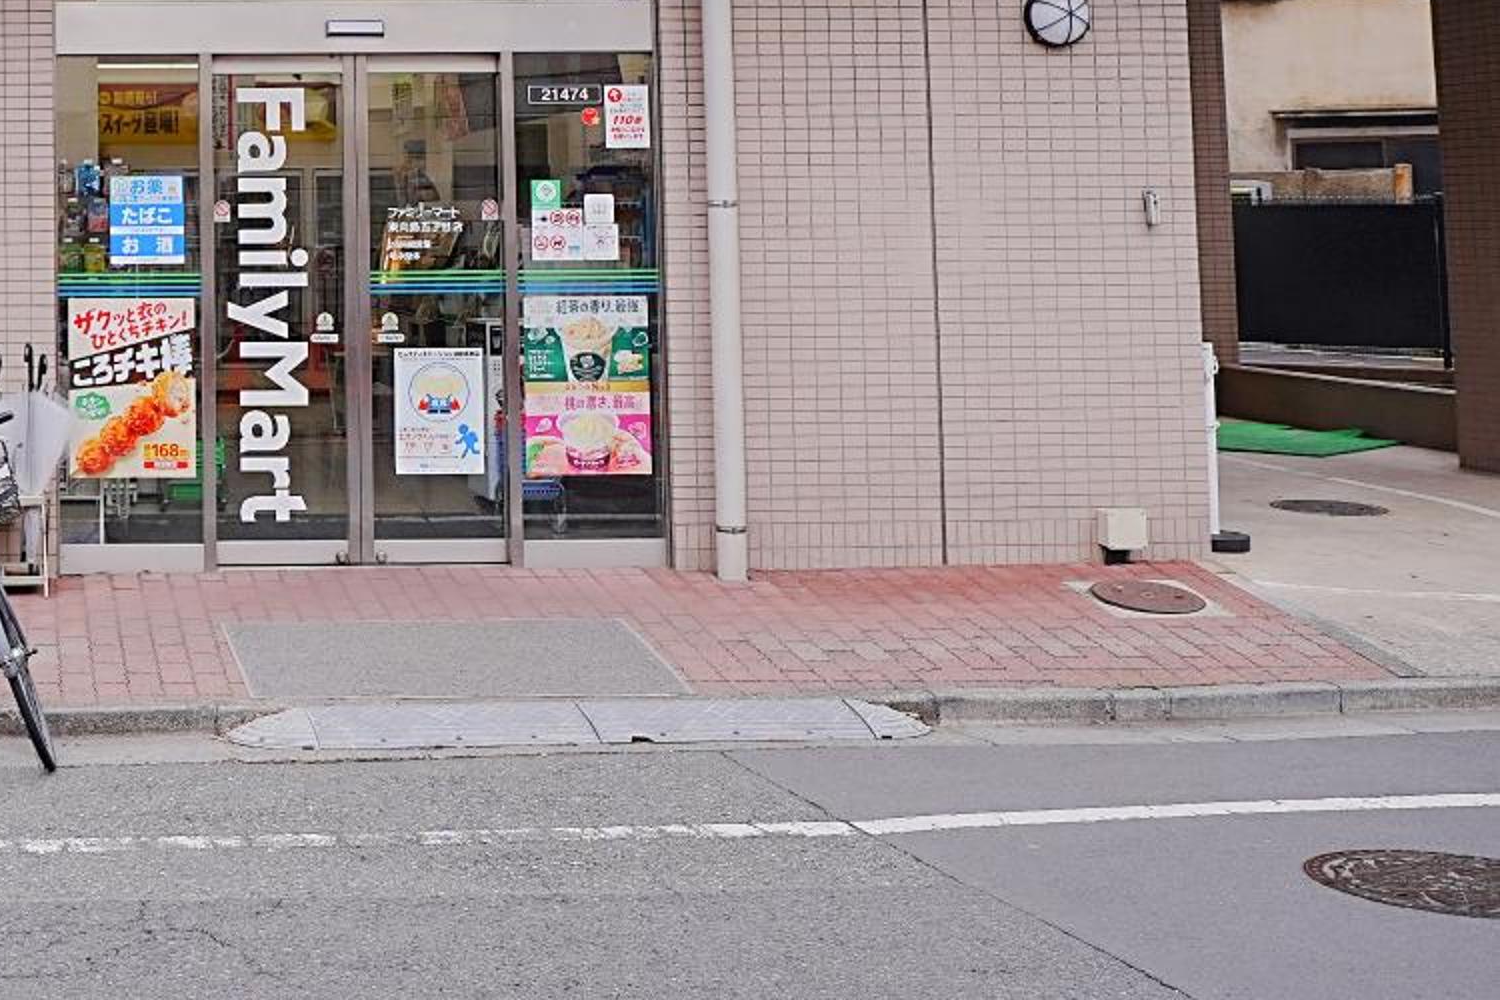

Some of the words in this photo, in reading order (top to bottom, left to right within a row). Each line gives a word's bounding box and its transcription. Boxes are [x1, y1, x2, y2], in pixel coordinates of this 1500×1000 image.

[541, 88, 589, 101] 21474
[121, 206, 173, 225] たばこ
[73, 302, 167, 335] ザクッと衣の
[227, 87, 308, 523] FamilyMart
[90, 310, 187, 349] ひとくちチキン!
[73, 333, 193, 387] ころチキ棒
